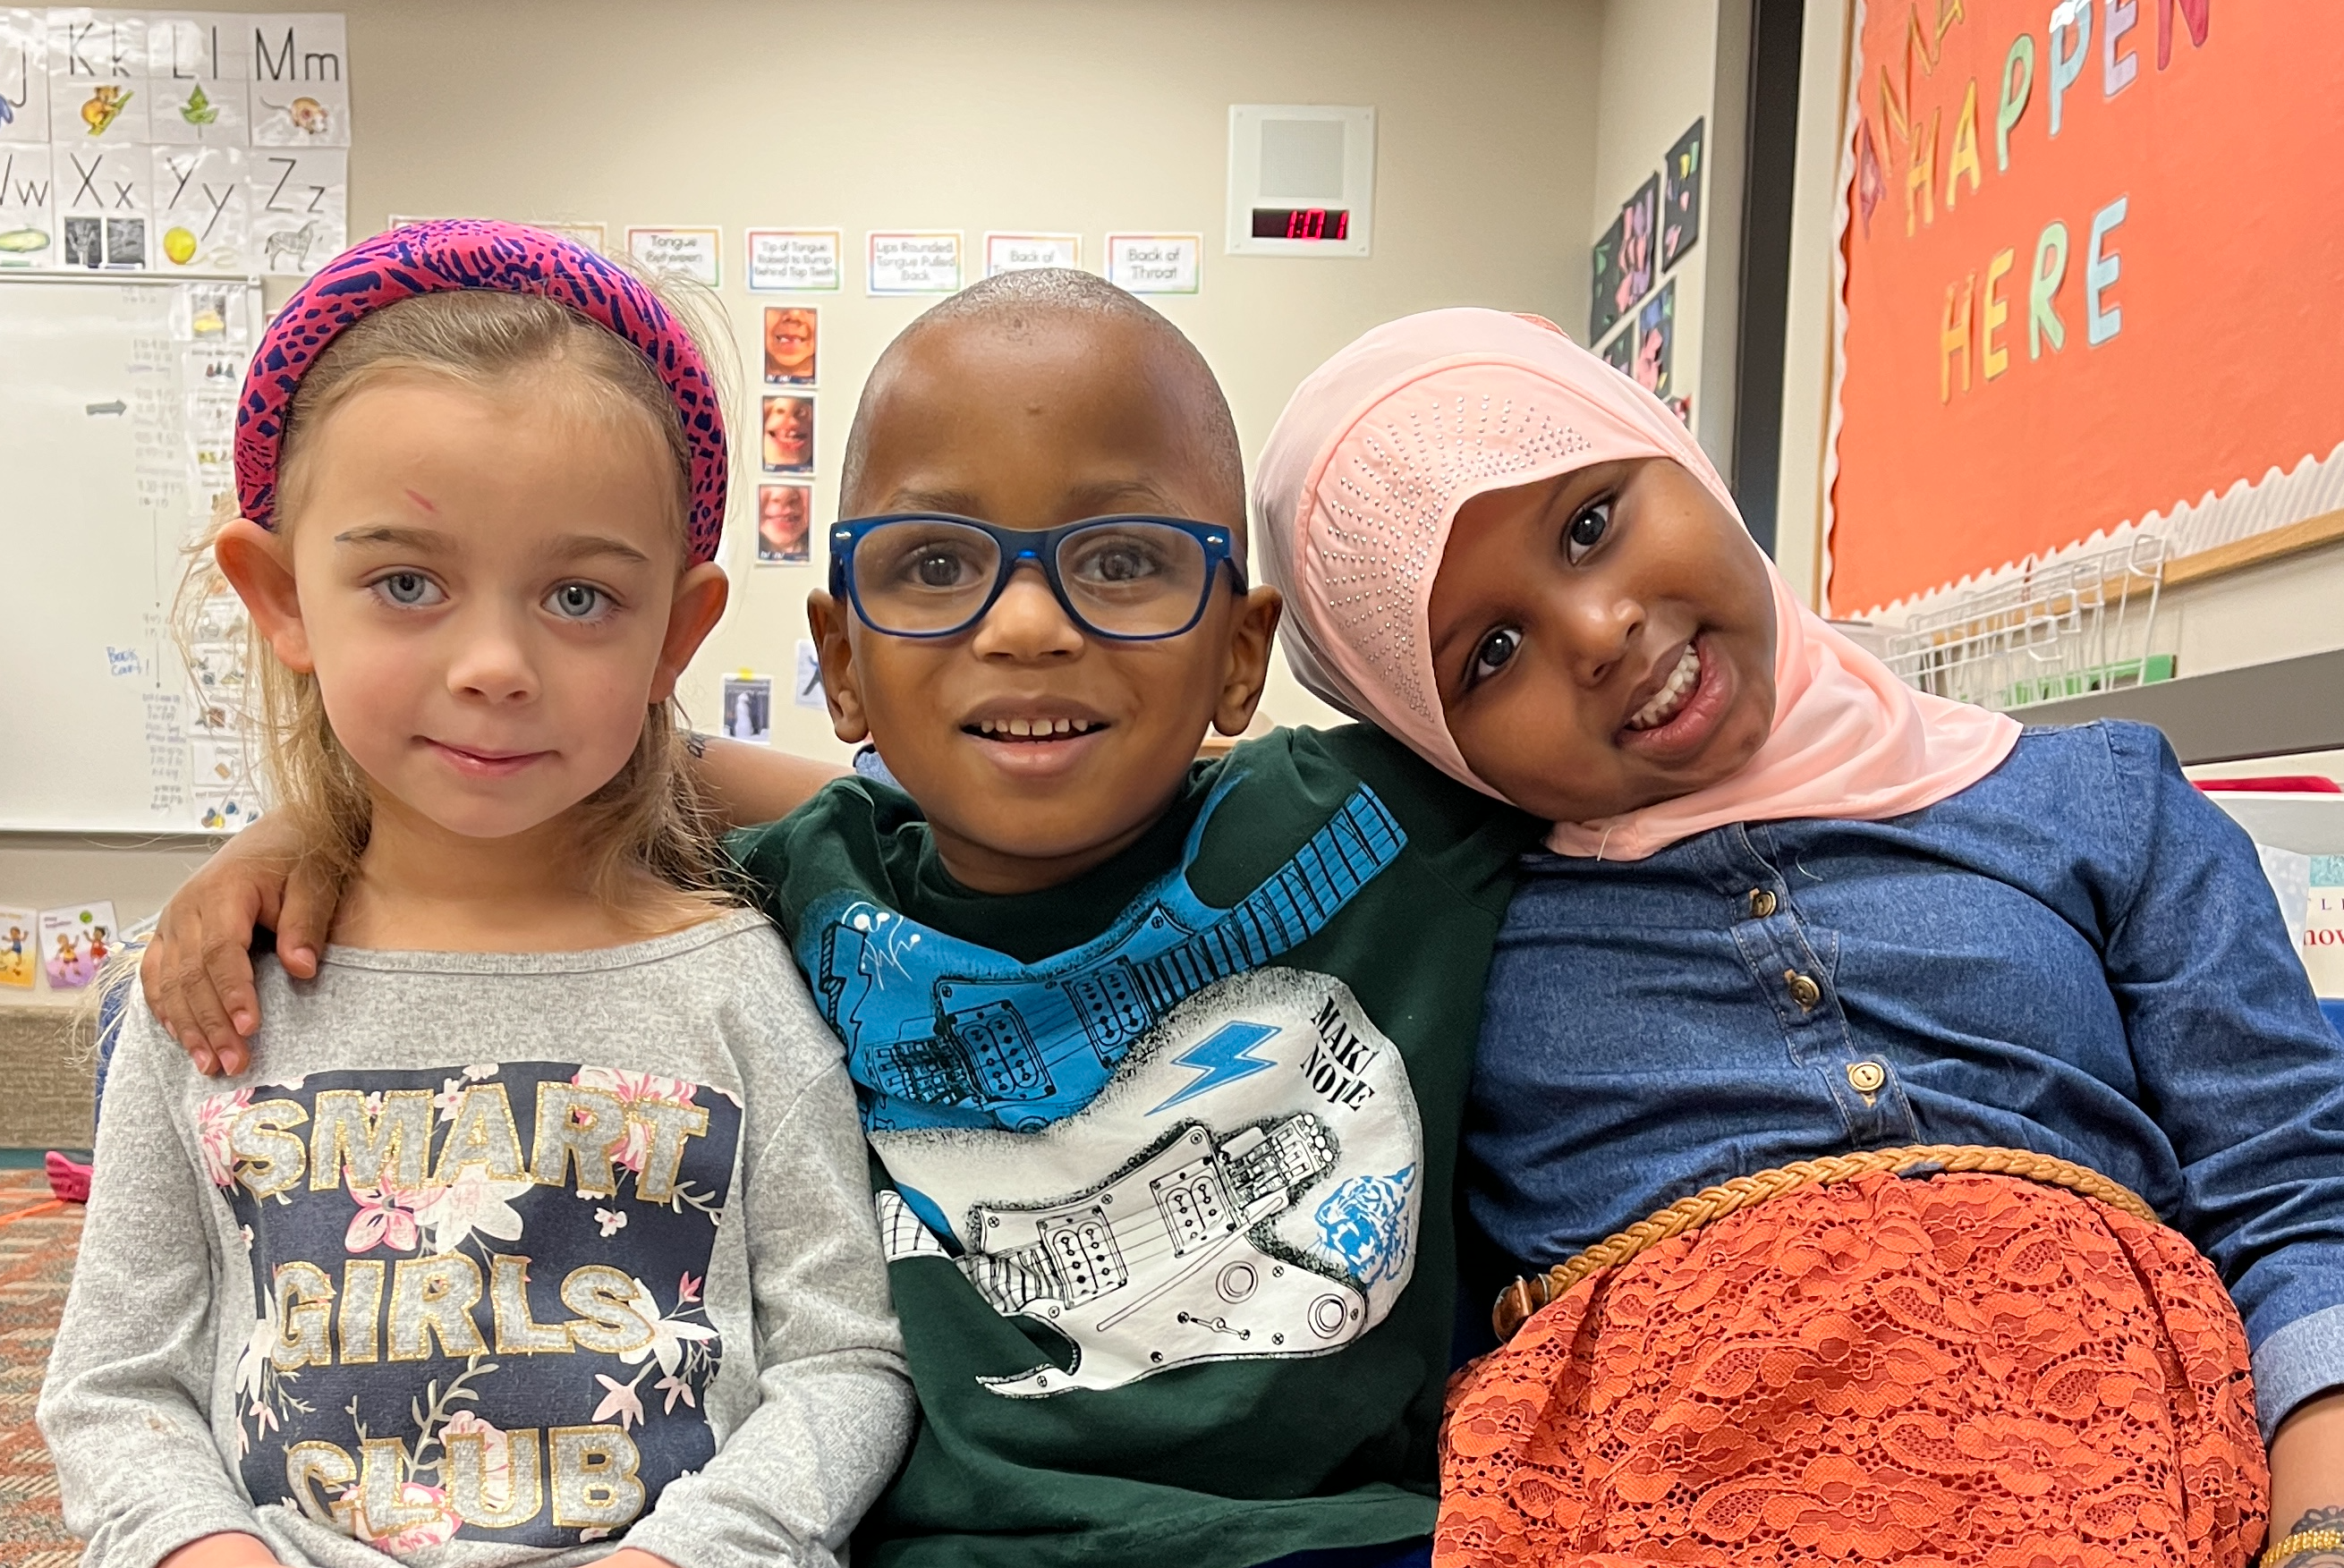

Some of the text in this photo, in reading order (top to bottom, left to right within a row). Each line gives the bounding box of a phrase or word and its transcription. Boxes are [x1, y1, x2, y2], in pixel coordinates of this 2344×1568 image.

[255, 27, 340, 81] Mm
[1906, 0, 2209, 238] HAPPEN
[650, 234, 698, 251] Tongue
[1128, 246, 1180, 261] Back of
[1286, 208, 1349, 242] 1:01
[1131, 265, 1177, 279] Throat
[1941, 193, 2128, 406] HERE
[1310, 996, 1380, 1076] MAK
[1300, 1042, 1376, 1112] NOIE
[228, 1080, 709, 1203] SMART
[270, 1251, 655, 1372] GIRLS
[284, 1424, 647, 1538] CLUB
